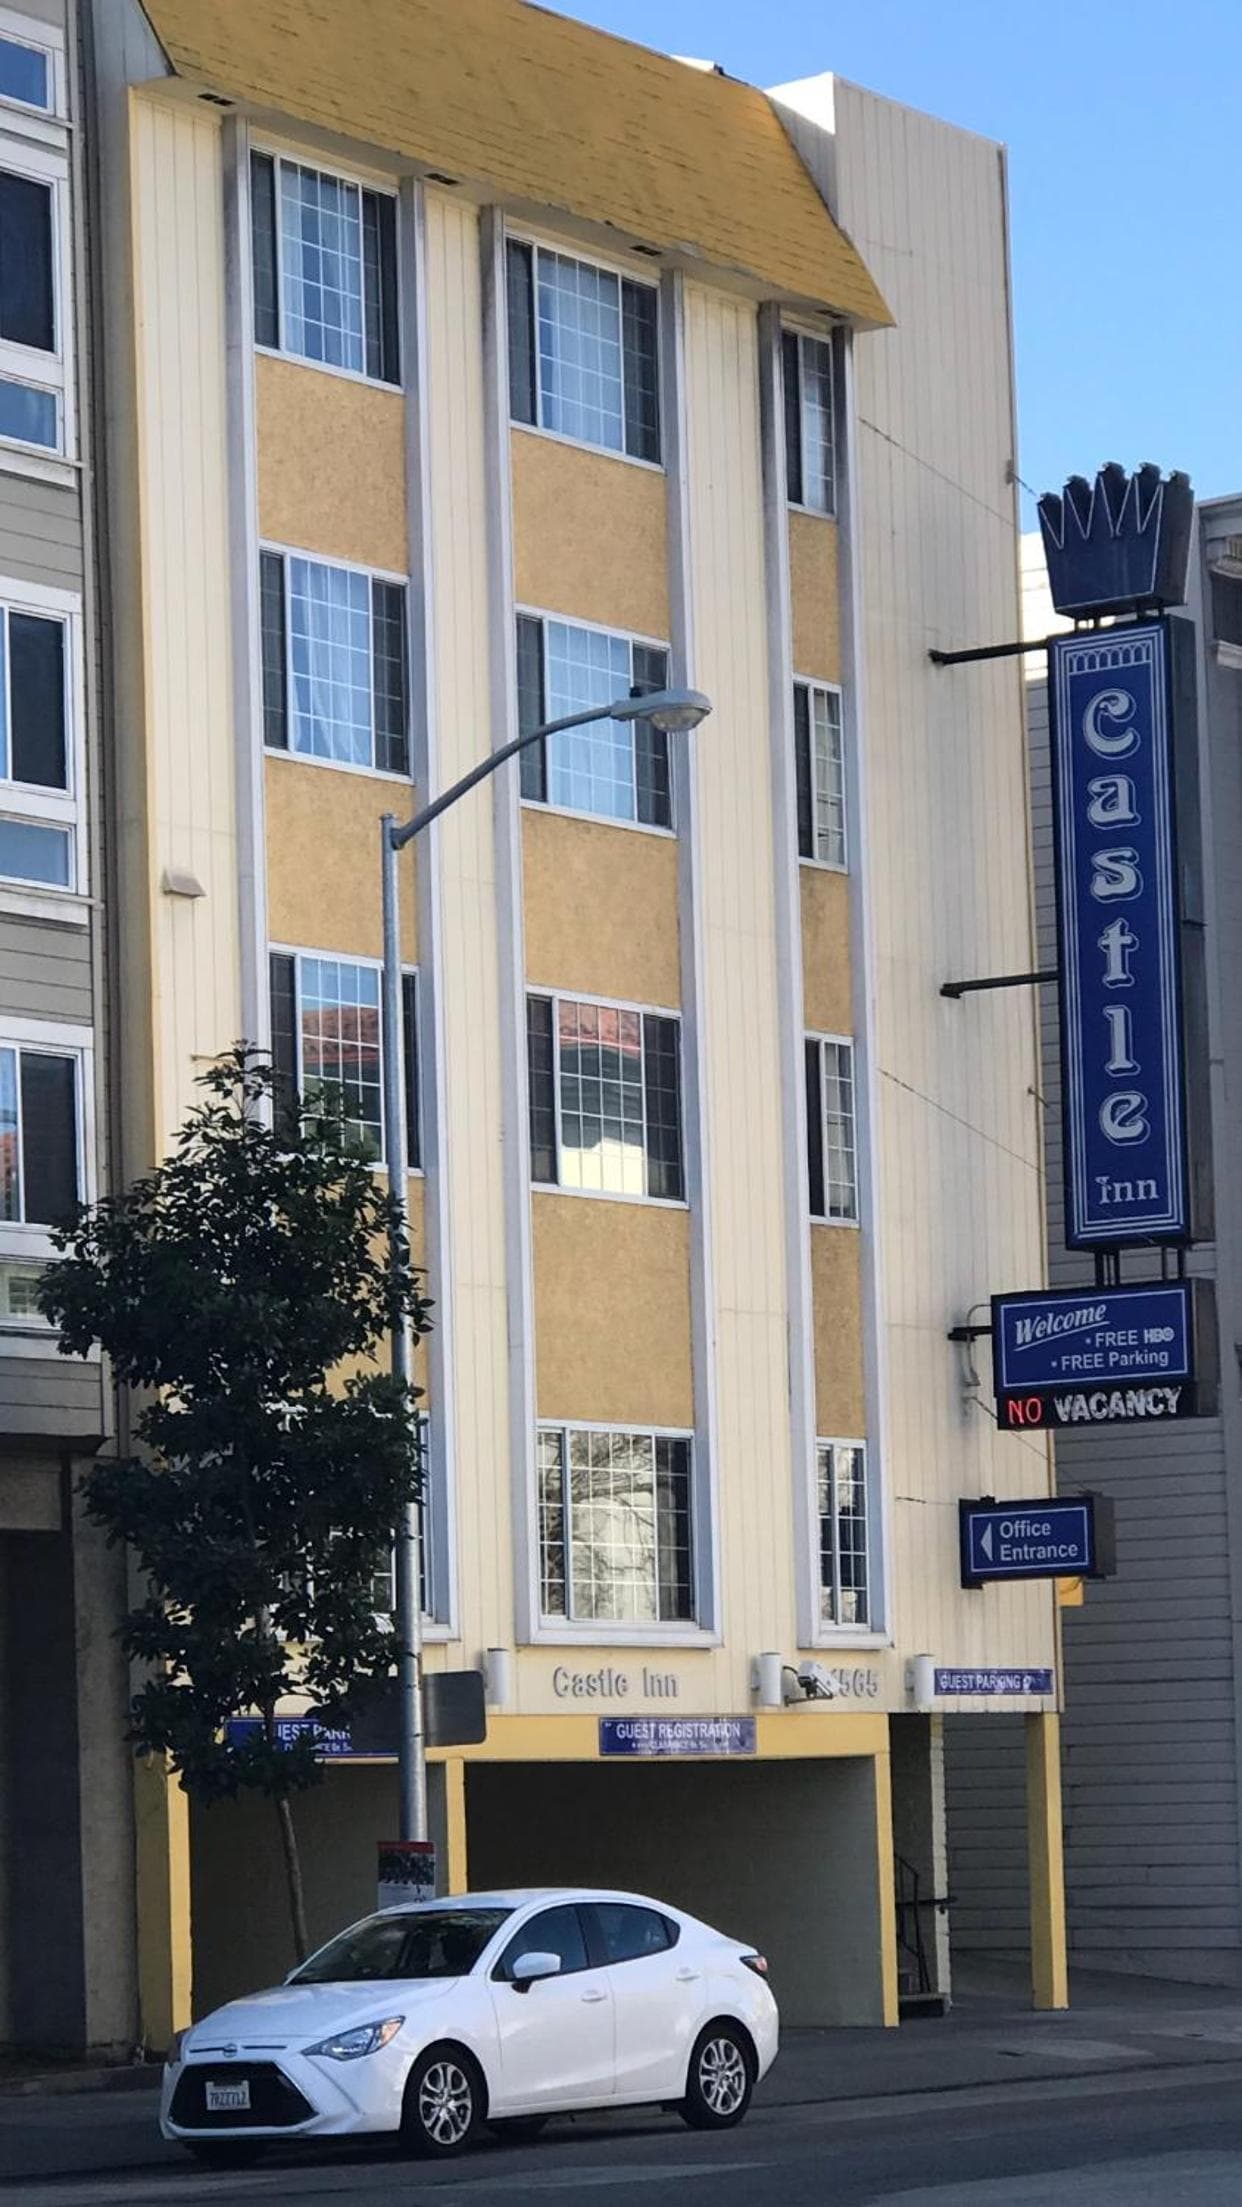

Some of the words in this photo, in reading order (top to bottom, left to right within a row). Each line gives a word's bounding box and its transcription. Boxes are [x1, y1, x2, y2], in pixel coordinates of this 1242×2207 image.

[1082, 686, 1151, 1147] Castle
[1014, 1304, 1107, 1345] Welcome
[1095, 1330, 1138, 1348] FREE
[1143, 1327, 1175, 1343] HBO
[1061, 1353, 1105, 1371] FREE
[1109, 1349, 1169, 1368] Parking
[1007, 1398, 1043, 1425] NO
[1053, 1386, 1182, 1422] VACANCY
[1000, 1520, 1052, 1539] Office
[1000, 1544, 1079, 1562] Entrance
[552, 1666, 628, 1698] Castle
[940, 1673, 974, 1690] GUEST
[615, 1723, 655, 1739] GUEST
[658, 1722, 741, 1738] REGISTRATION
